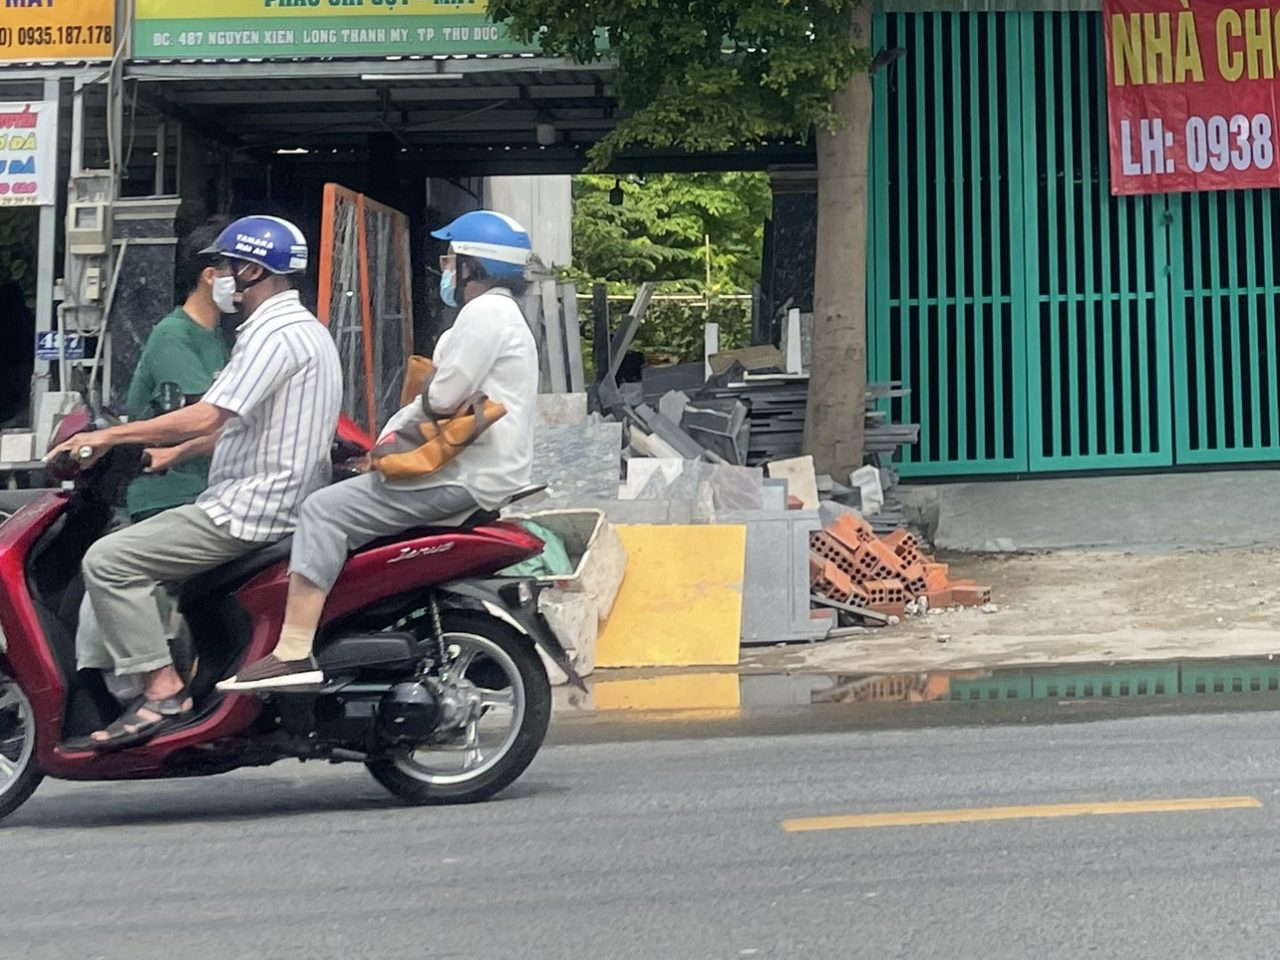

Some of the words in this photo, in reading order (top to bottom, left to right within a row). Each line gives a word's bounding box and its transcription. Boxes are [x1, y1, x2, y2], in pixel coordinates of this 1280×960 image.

[18, 25, 112, 46] 0935.187.178
[178, 32, 203, 46] 487
[303, 28, 337, 44] LONG
[1120, 117, 1175, 176] LH:
[1185, 113, 1274, 174] 0938
